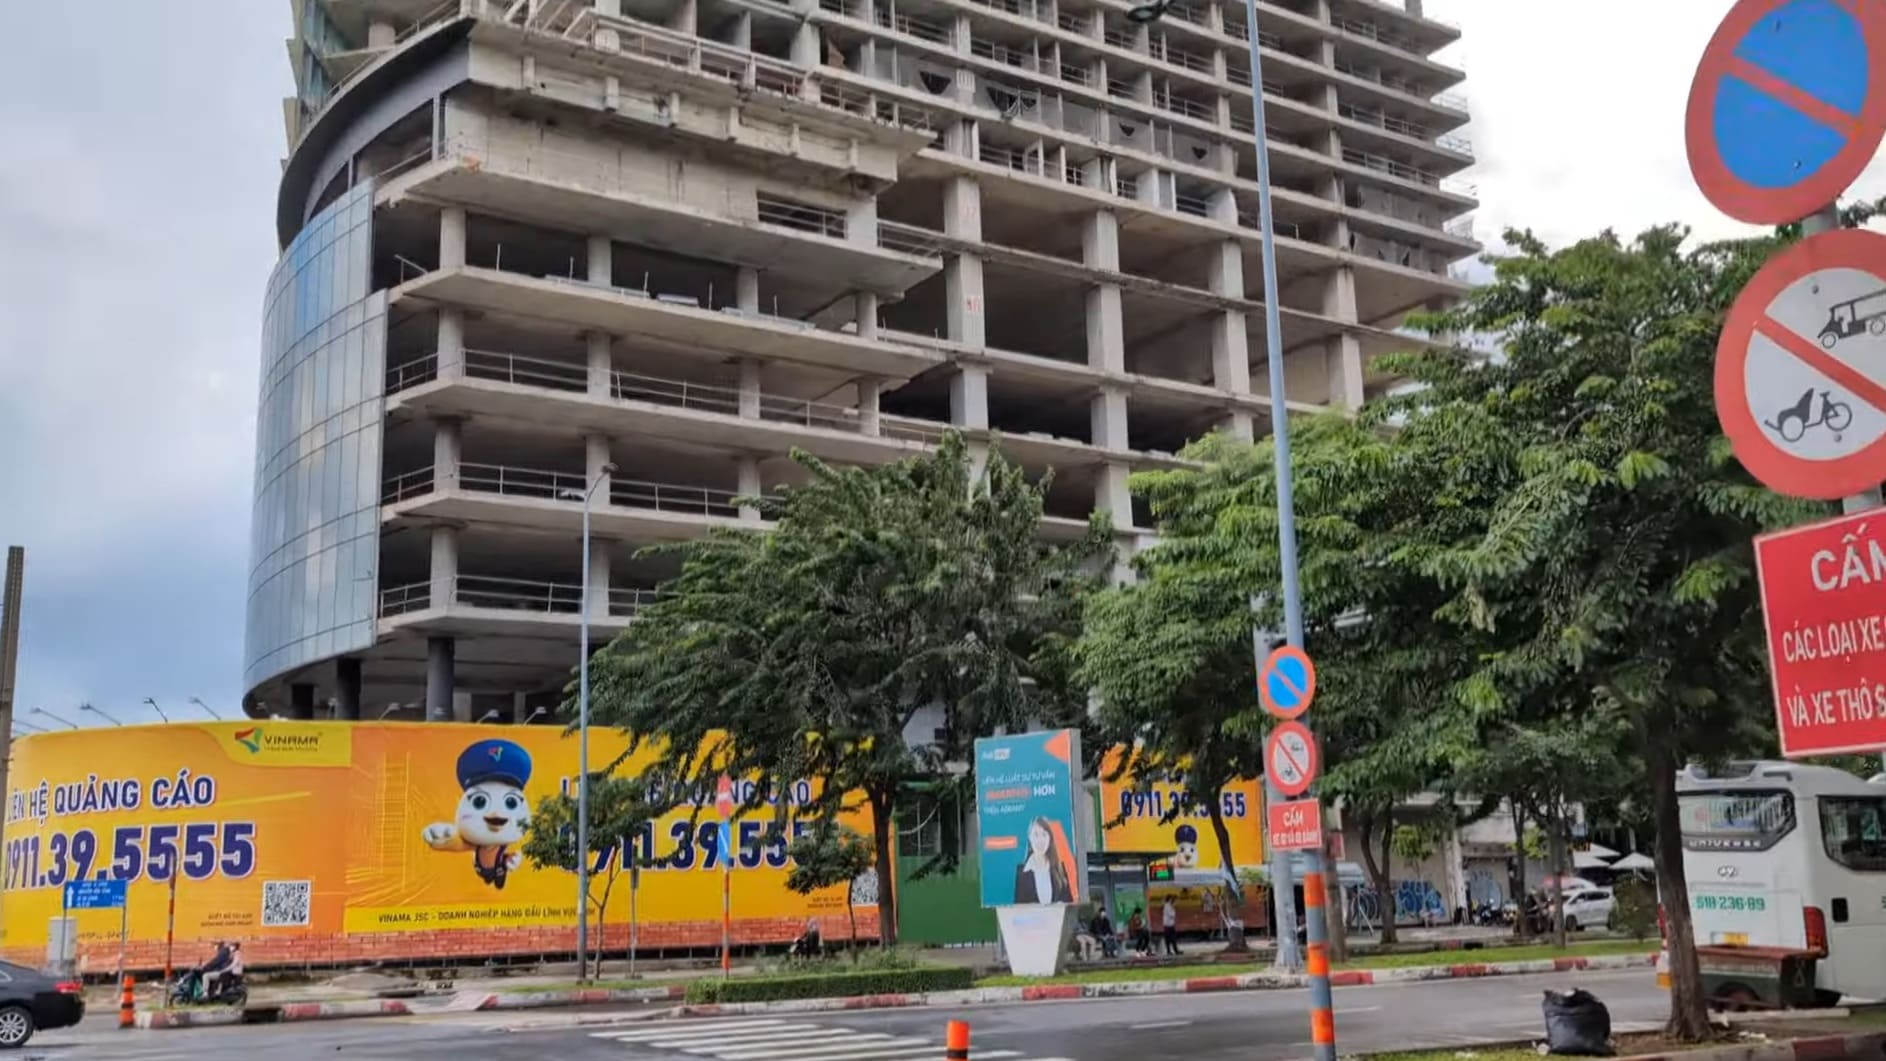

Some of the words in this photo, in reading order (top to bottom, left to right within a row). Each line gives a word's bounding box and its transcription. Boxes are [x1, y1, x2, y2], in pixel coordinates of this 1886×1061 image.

[1783, 620, 1816, 662] CÁC
[1818, 622, 1857, 663] LOẠI
[1858, 615, 1885, 652] XE
[1787, 684, 1810, 727] VÀ
[1811, 691, 1836, 725] XE
[1837, 677, 1873, 721] THÔ
[29, 780, 48, 825] HỆ
[54, 775, 139, 814] QUẢNG
[151, 769, 214, 807] CÁO
